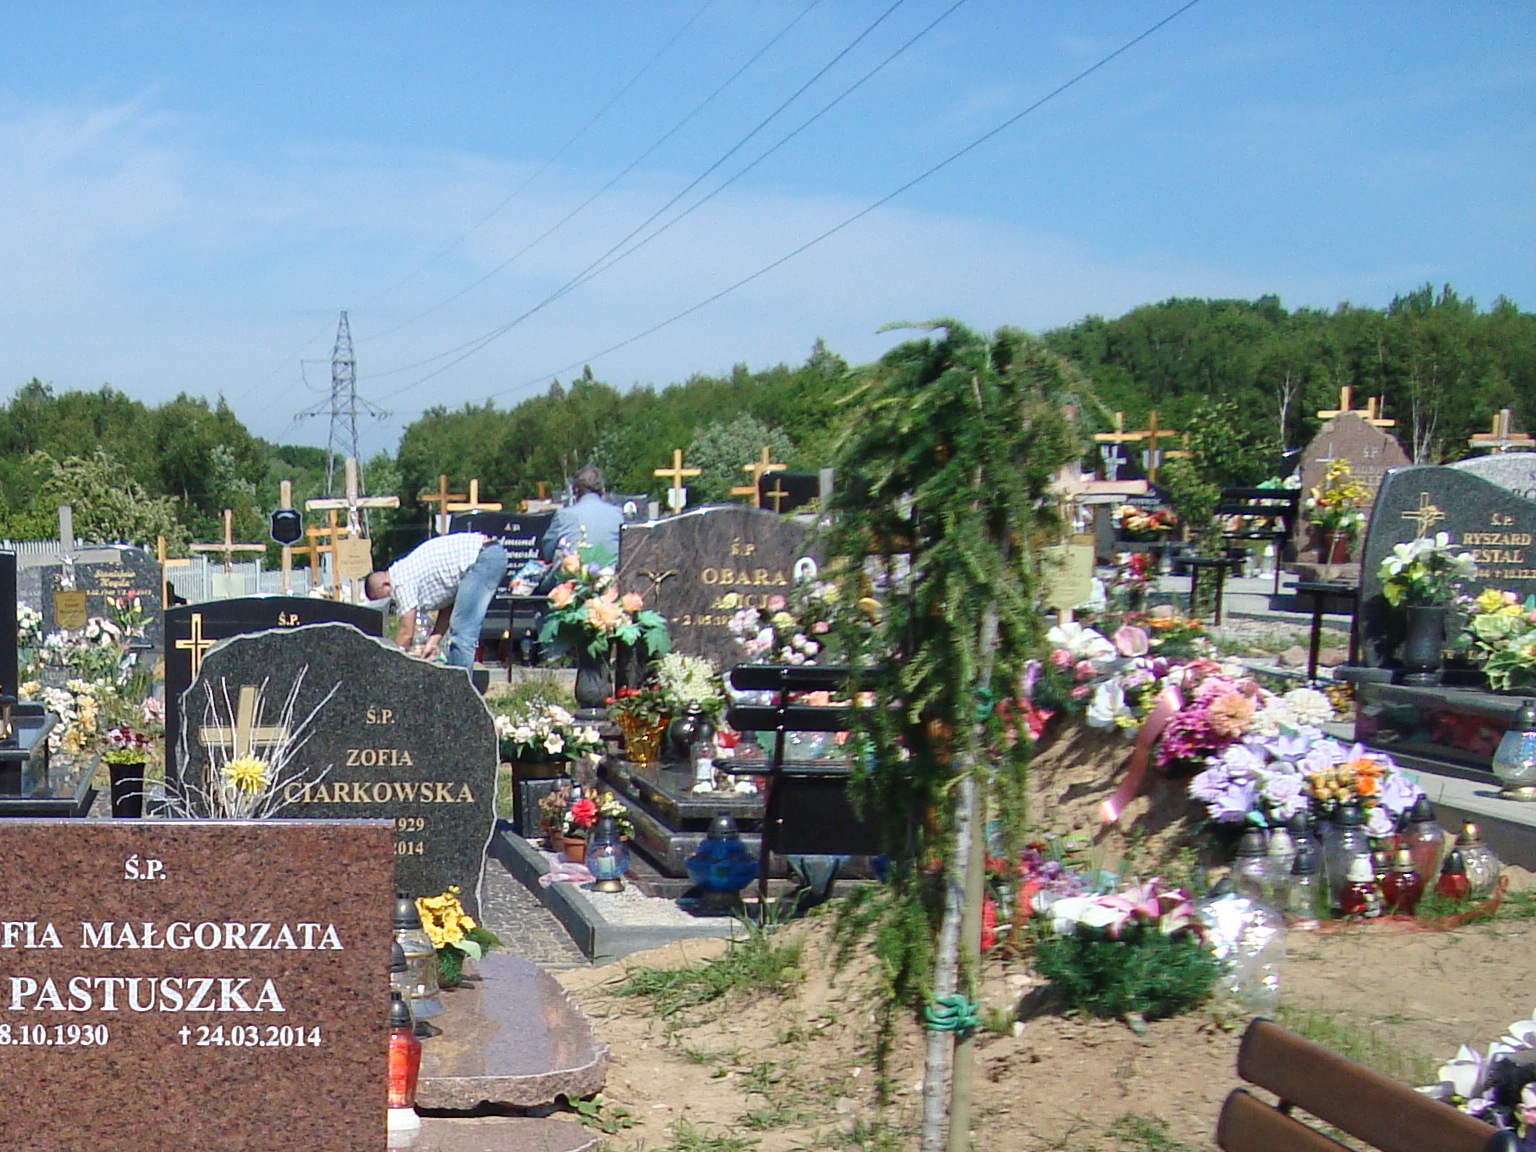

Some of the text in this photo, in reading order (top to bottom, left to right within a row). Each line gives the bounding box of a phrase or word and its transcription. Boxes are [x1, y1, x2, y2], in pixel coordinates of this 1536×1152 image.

[1462, 532, 1532, 546] RYSZARD
[700, 567, 789, 586] OBARA
[277, 611, 301, 626] Ś.P.
[365, 706, 396, 724] Ś.P.
[346, 749, 413, 767] ZOFIA
[283, 782, 475, 803] CIARKOWSKA
[395, 817, 425, 832] 929
[124, 854, 167, 880] Ś.P.
[80, 922, 344, 951] MAŁGORZATA
[7, 976, 285, 1013] PASTUSZKA
